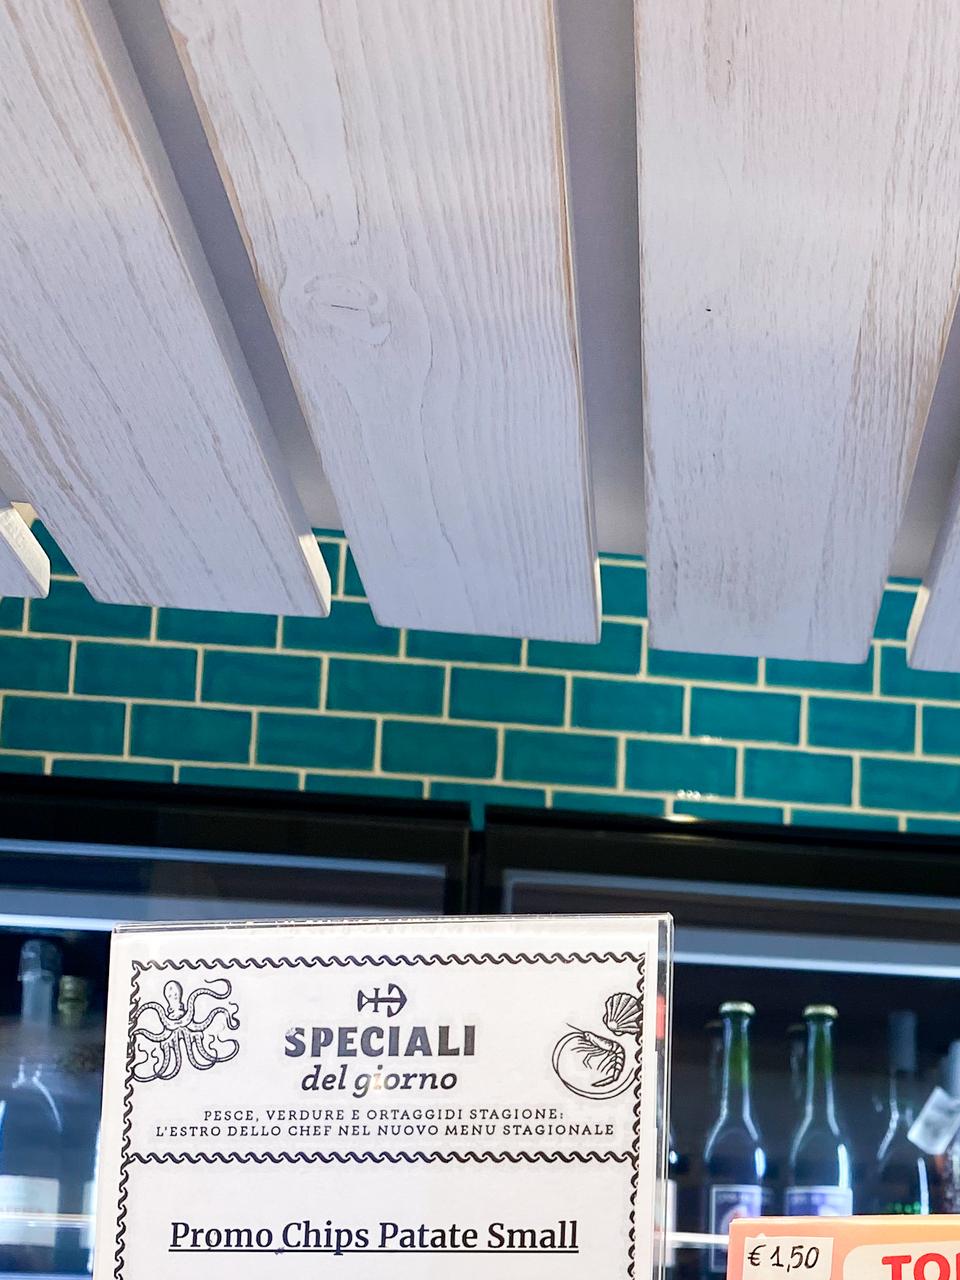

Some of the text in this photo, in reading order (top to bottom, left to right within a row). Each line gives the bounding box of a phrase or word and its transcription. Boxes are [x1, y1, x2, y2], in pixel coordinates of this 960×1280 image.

[285, 1025, 475, 1057] SPECIALI
[302, 1064, 457, 1098] del giorno
[156, 1124, 613, 1137] L'ESTRO DELLO CHEF NEL NUOVO MENU STAGIONALE
[204, 1109, 563, 1122] PESCE, VERDURE E ORTAGGIDI STAGIONE:
[169, 1220, 578, 1255] Promo Chips Patate Small
[748, 1244, 819, 1272] € 1,50
